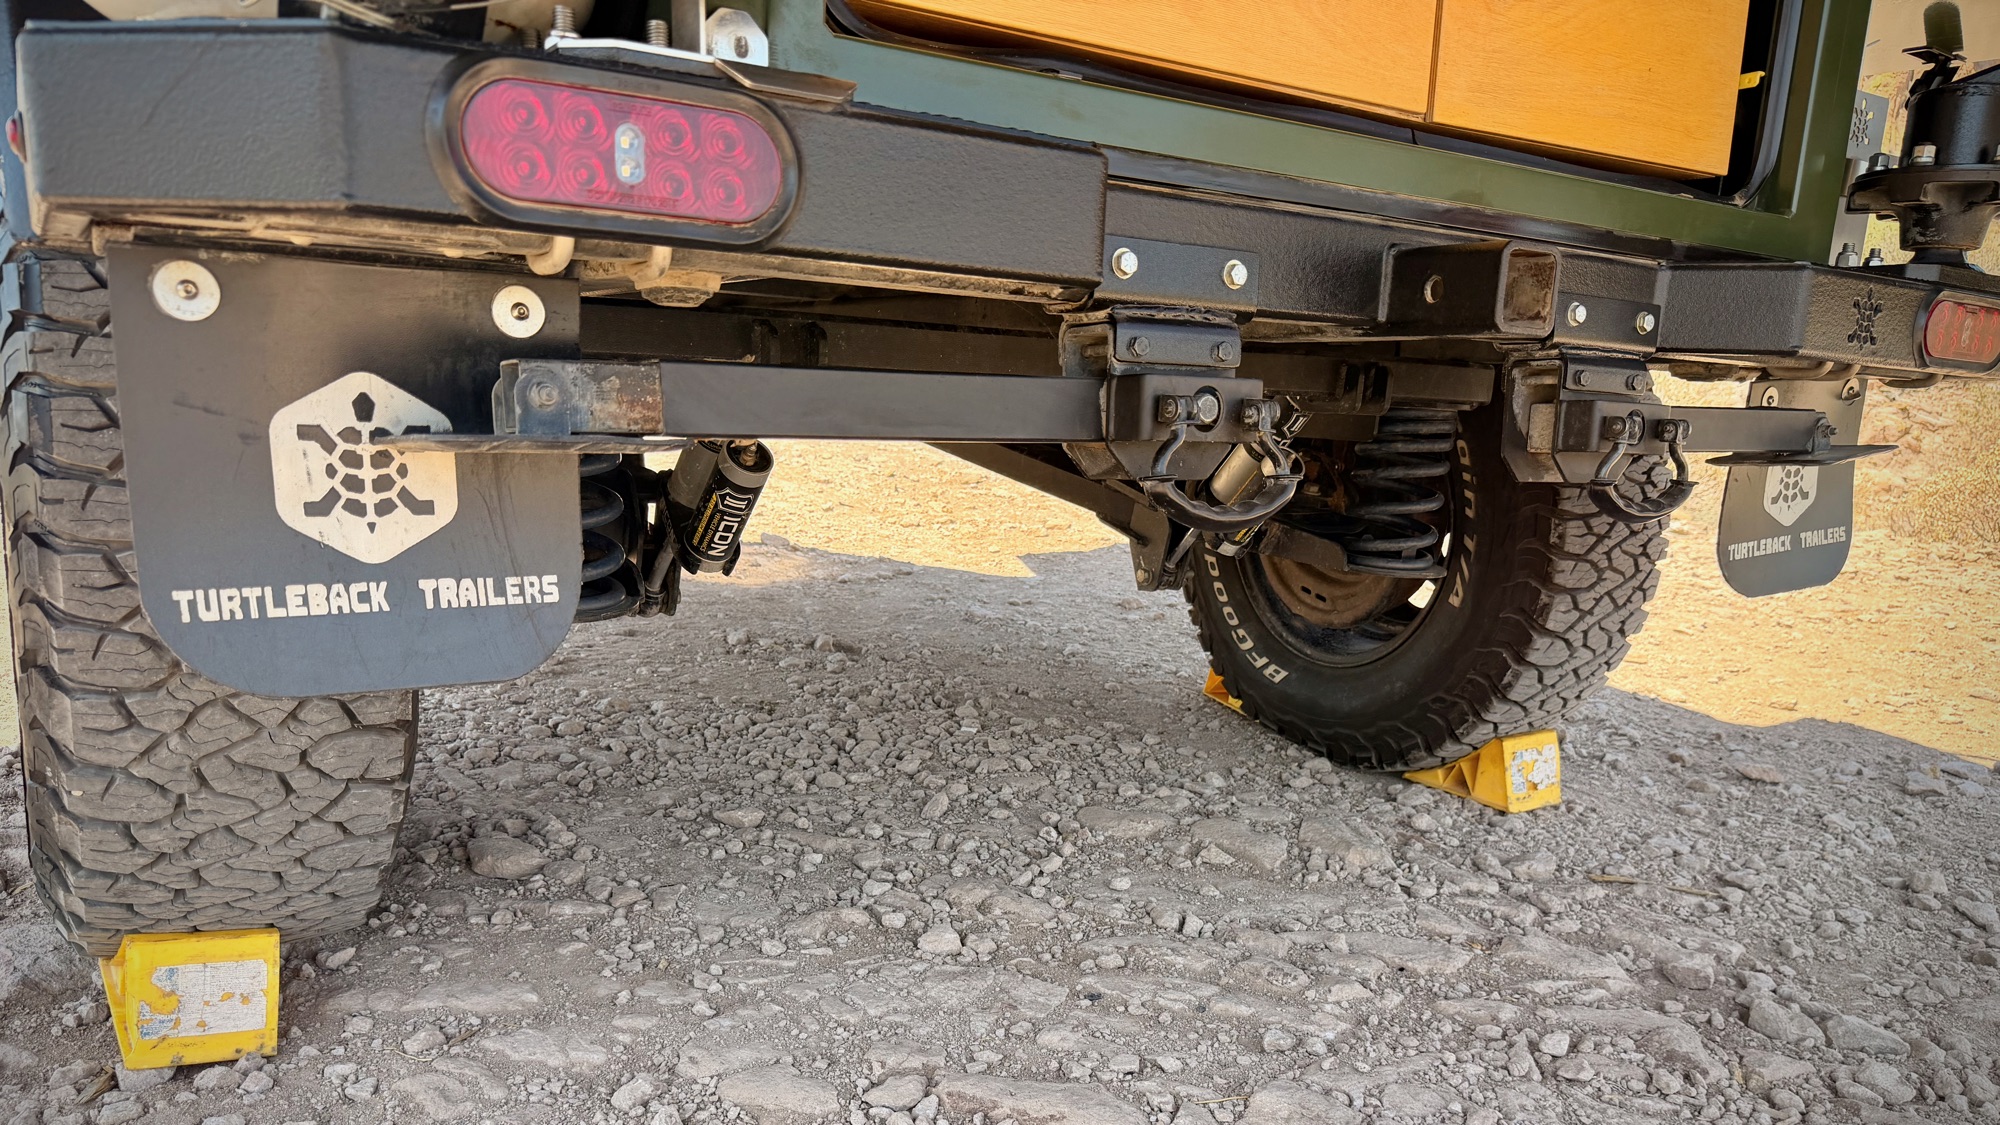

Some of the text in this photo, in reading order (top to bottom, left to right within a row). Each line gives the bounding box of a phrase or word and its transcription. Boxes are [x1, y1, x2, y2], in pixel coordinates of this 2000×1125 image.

[707, 515, 742, 557] ICON
[1728, 526, 1847, 561] TURTLEBACK TRAILERS
[1448, 534, 1477, 608] T/A
[172, 574, 560, 623] TURTLEBACK TRAILERS
[1204, 553, 1289, 684] BFGood
